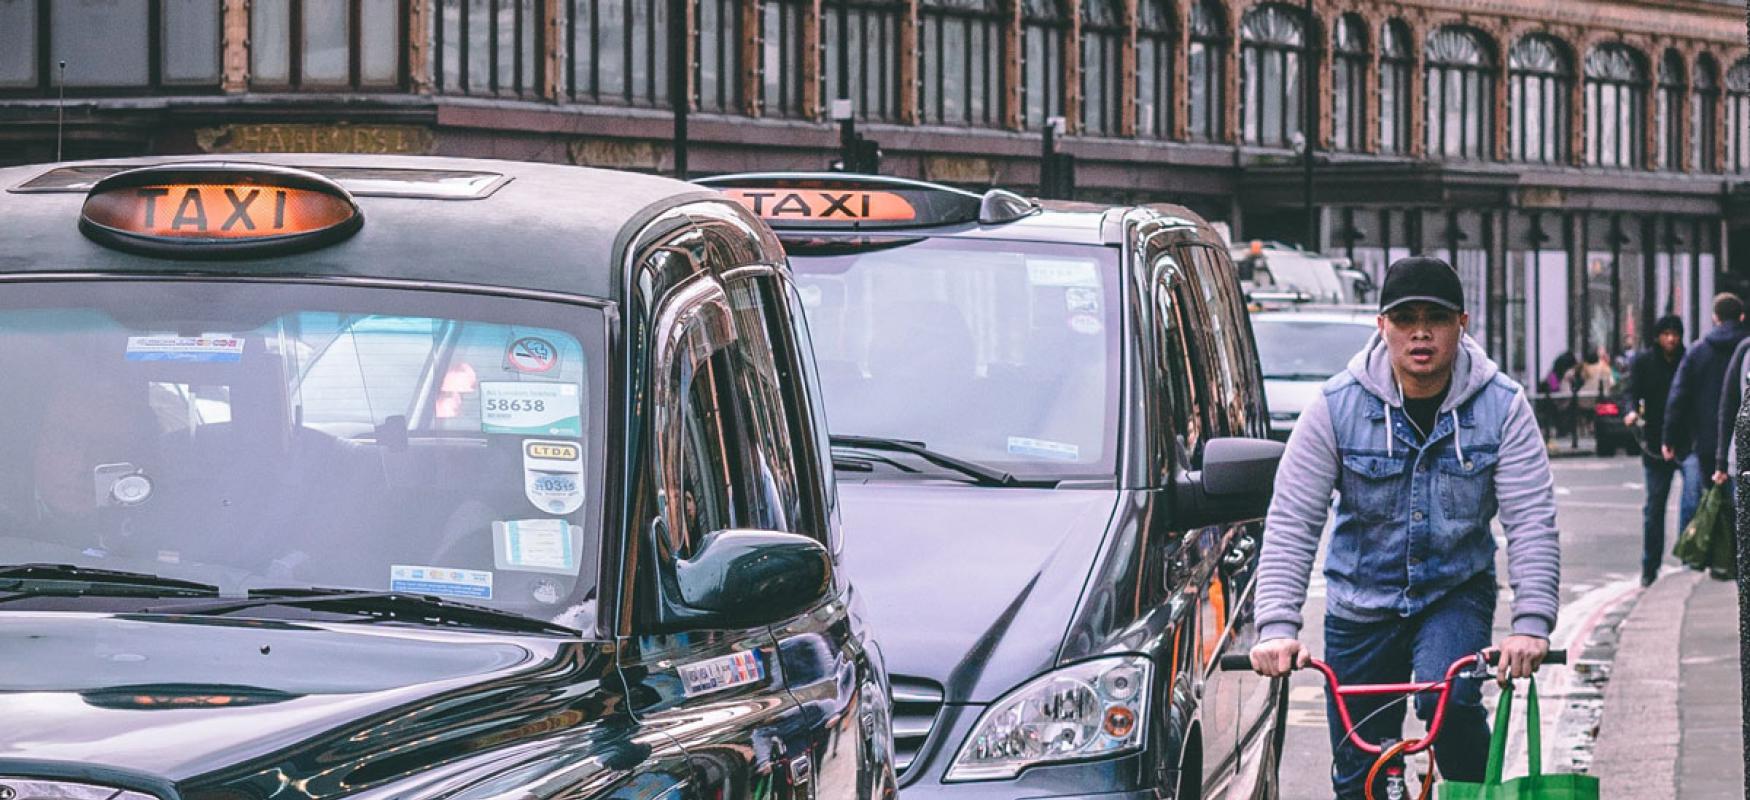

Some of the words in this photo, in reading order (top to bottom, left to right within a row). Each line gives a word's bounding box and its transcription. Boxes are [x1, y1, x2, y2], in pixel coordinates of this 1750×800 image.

[136, 187, 287, 231] TAXI
[742, 193, 870, 218] TAXI
[486, 399, 545, 412] 58638
[534, 447, 571, 456] LTDA
